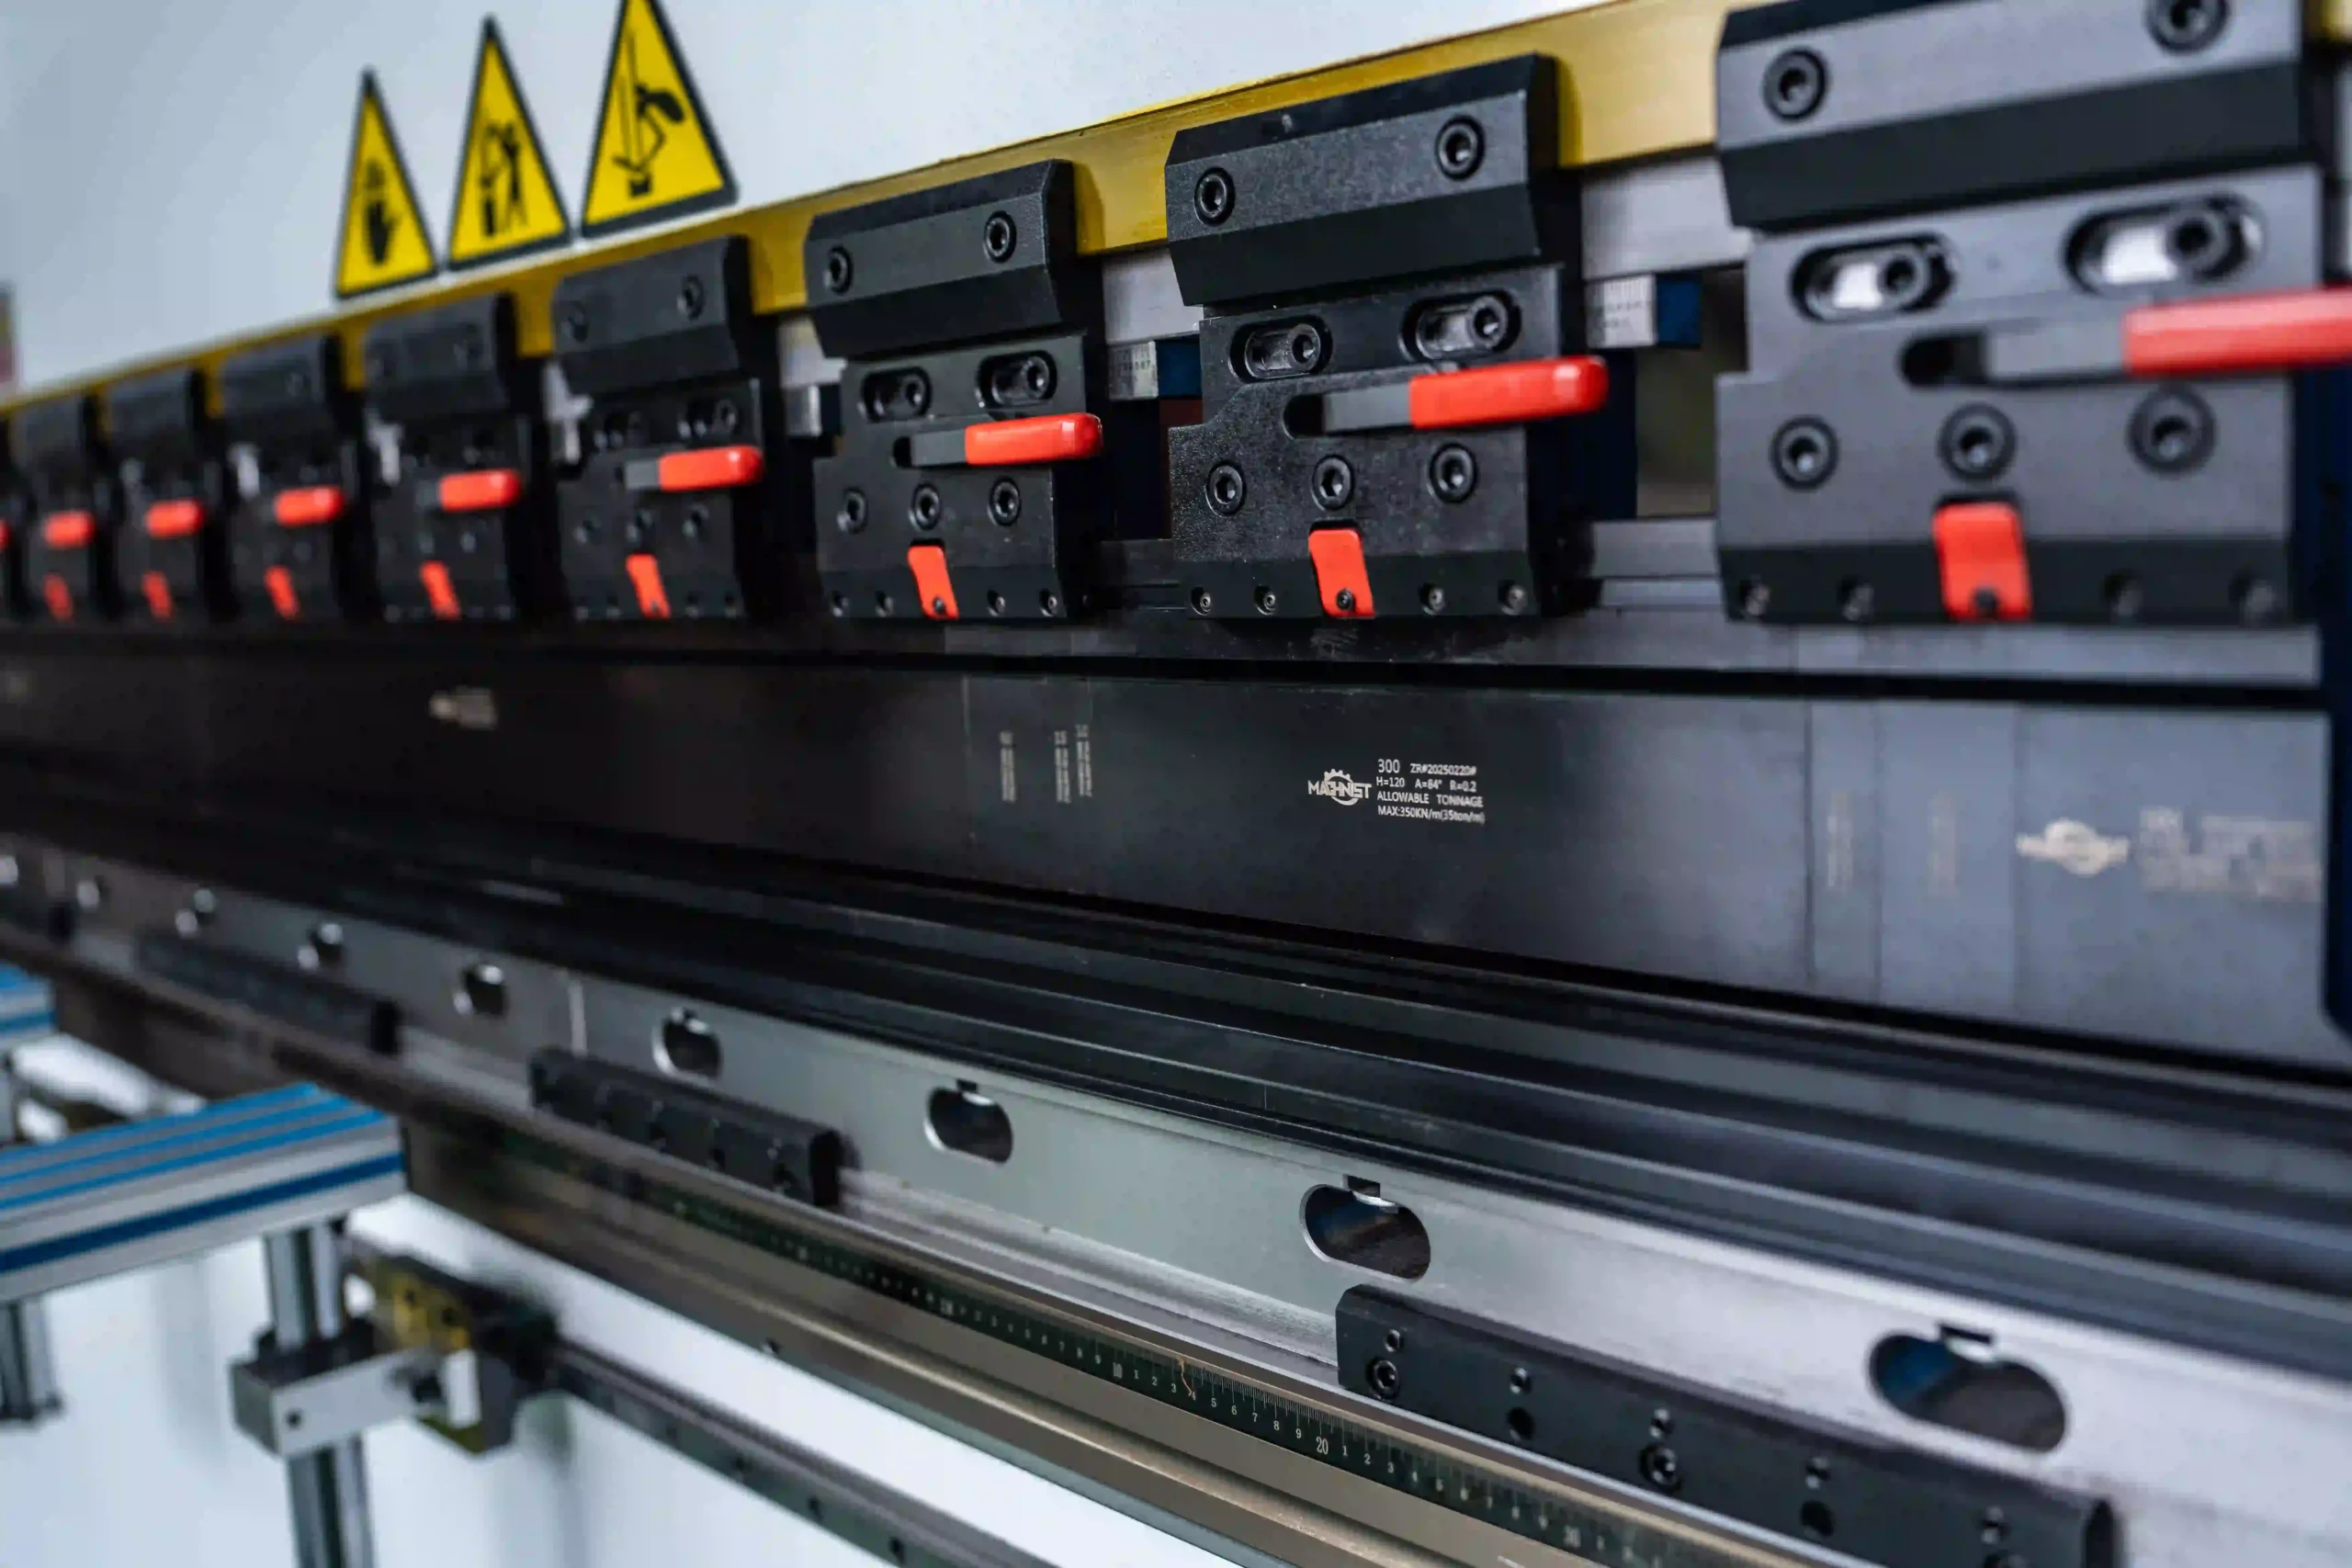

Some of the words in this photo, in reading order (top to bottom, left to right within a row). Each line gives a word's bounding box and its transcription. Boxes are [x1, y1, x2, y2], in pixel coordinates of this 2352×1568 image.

[1378, 759, 1400, 773] 300
[1376, 776, 1405, 787] H=120
[1377, 791, 1430, 805] ALLOWABLE
[1436, 794, 1484, 808] TONNAGE
[1151, 1376, 1159, 1387] 2
[1170, 1382, 1177, 1393] 3
[1211, 1397, 1217, 1408] 5
[1231, 1404, 1238, 1416] 6
[1251, 1412, 1259, 1423] 7
[1273, 1420, 1280, 1431] 8
[1295, 1427, 1302, 1439] 9
[1316, 1436, 1329, 1455] 20
[1342, 1445, 1349, 1457] 1
[1363, 1452, 1371, 1465] 2
[1387, 1461, 1395, 1474] 3
